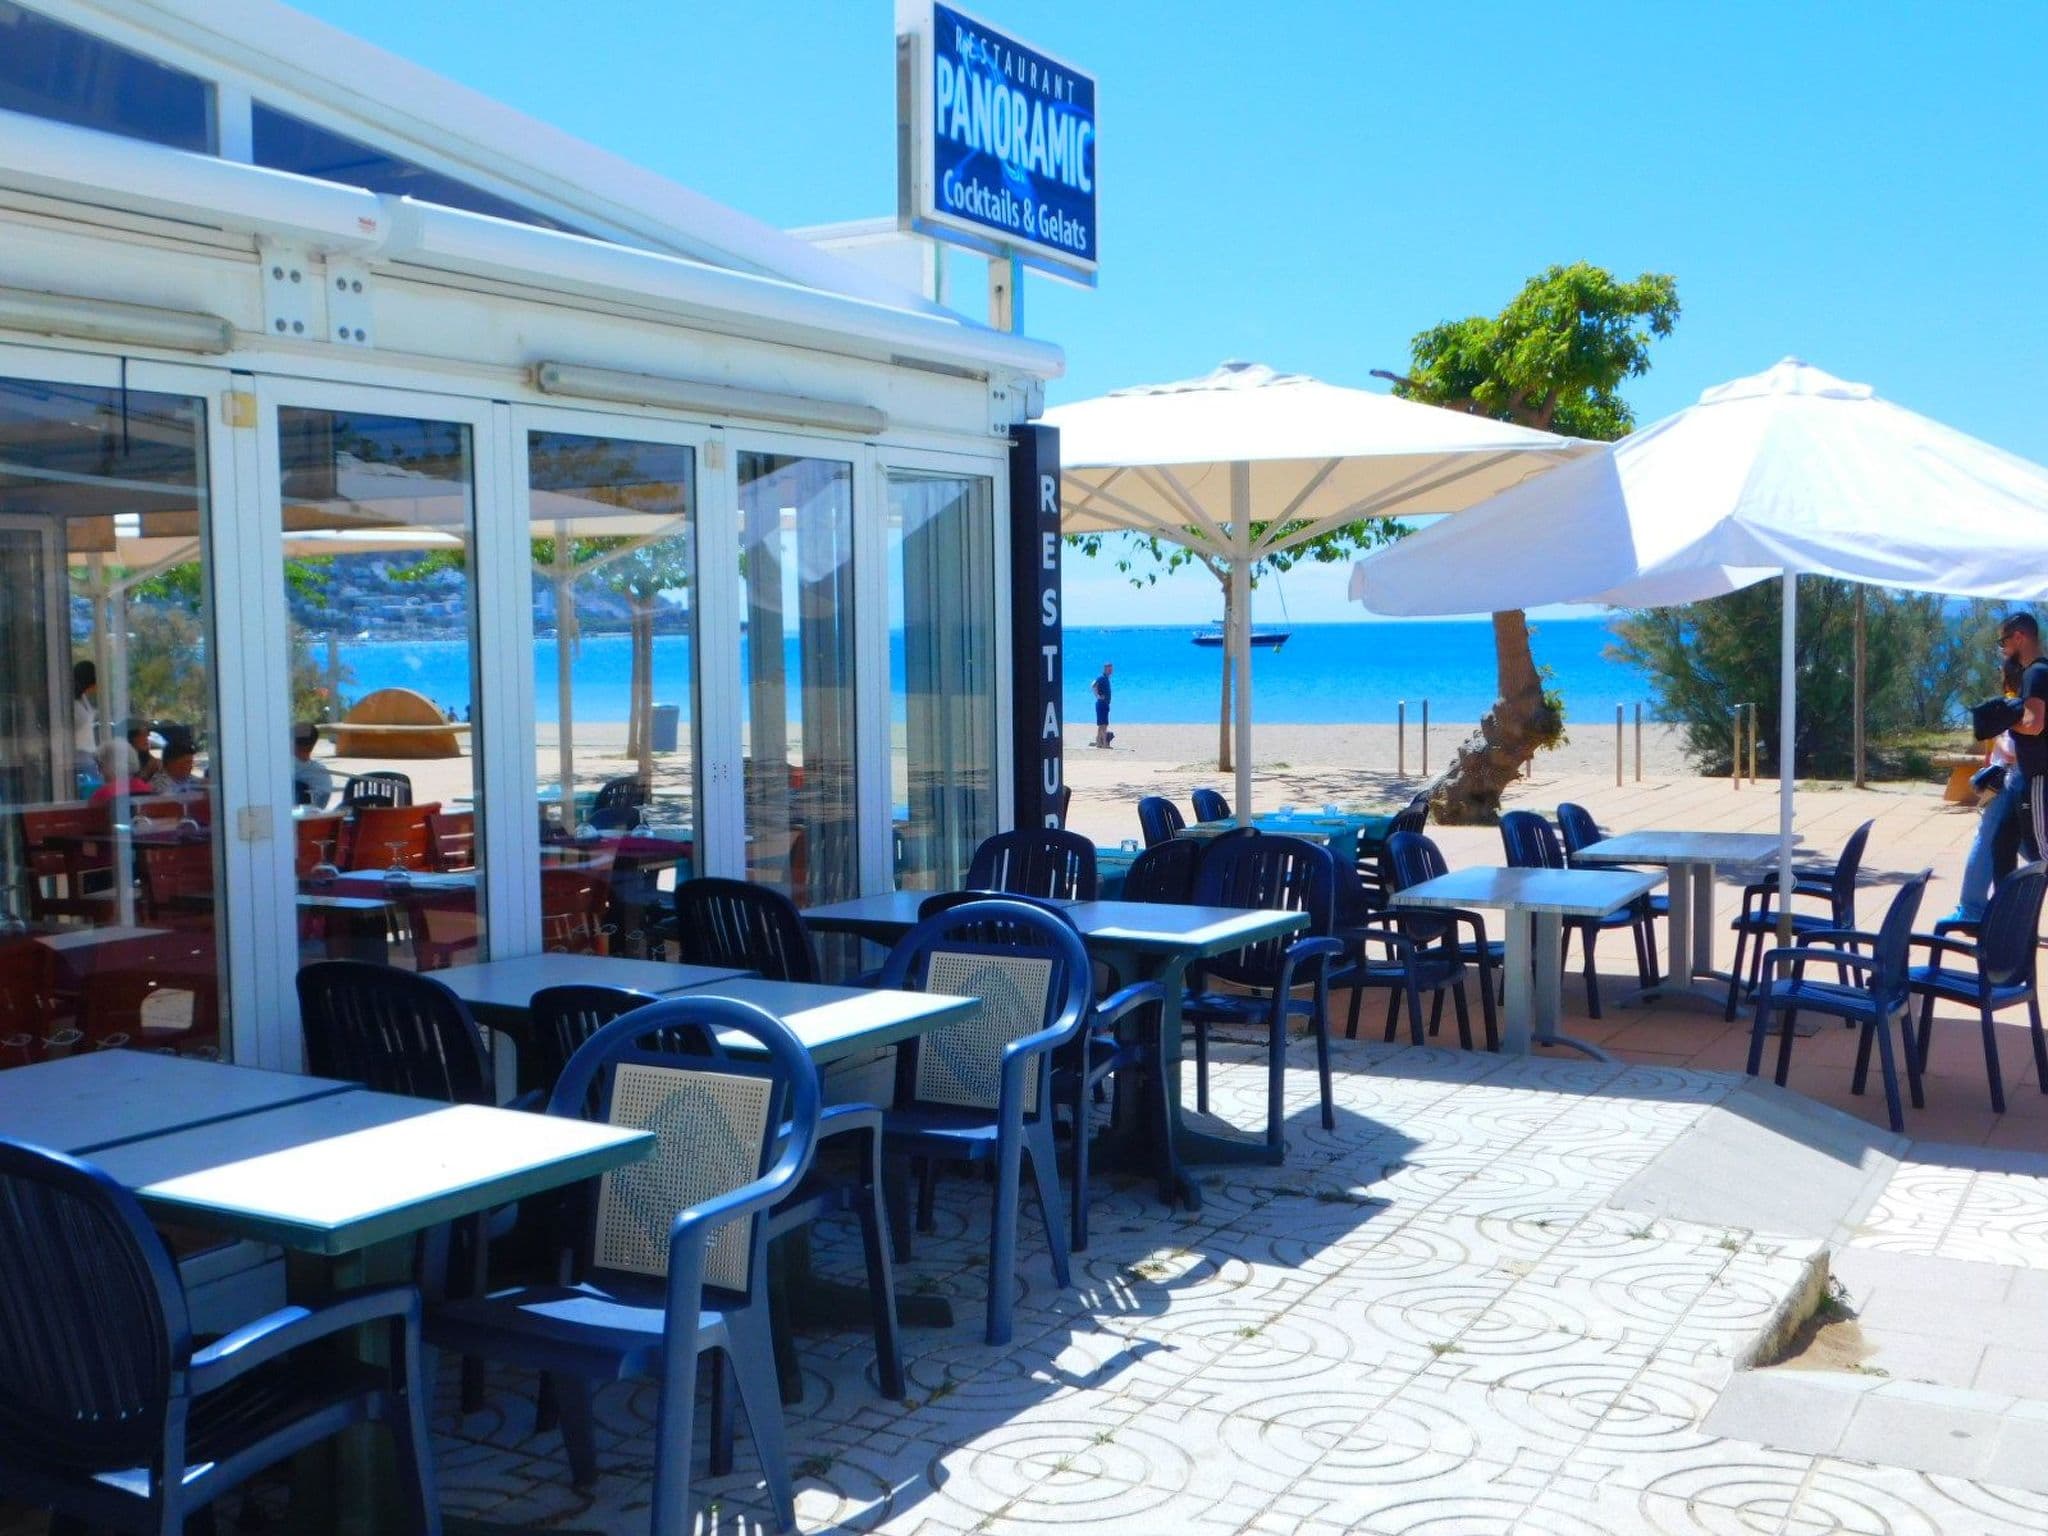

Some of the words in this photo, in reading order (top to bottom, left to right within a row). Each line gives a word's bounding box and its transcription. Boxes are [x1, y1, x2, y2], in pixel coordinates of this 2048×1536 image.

[955, 23, 1074, 105] RESTAURANT
[937, 55, 1092, 194] PANORAMIC
[943, 169, 1020, 229] Cocktails
[1023, 198, 1036, 234] &
[1038, 203, 1087, 251] Gelats
